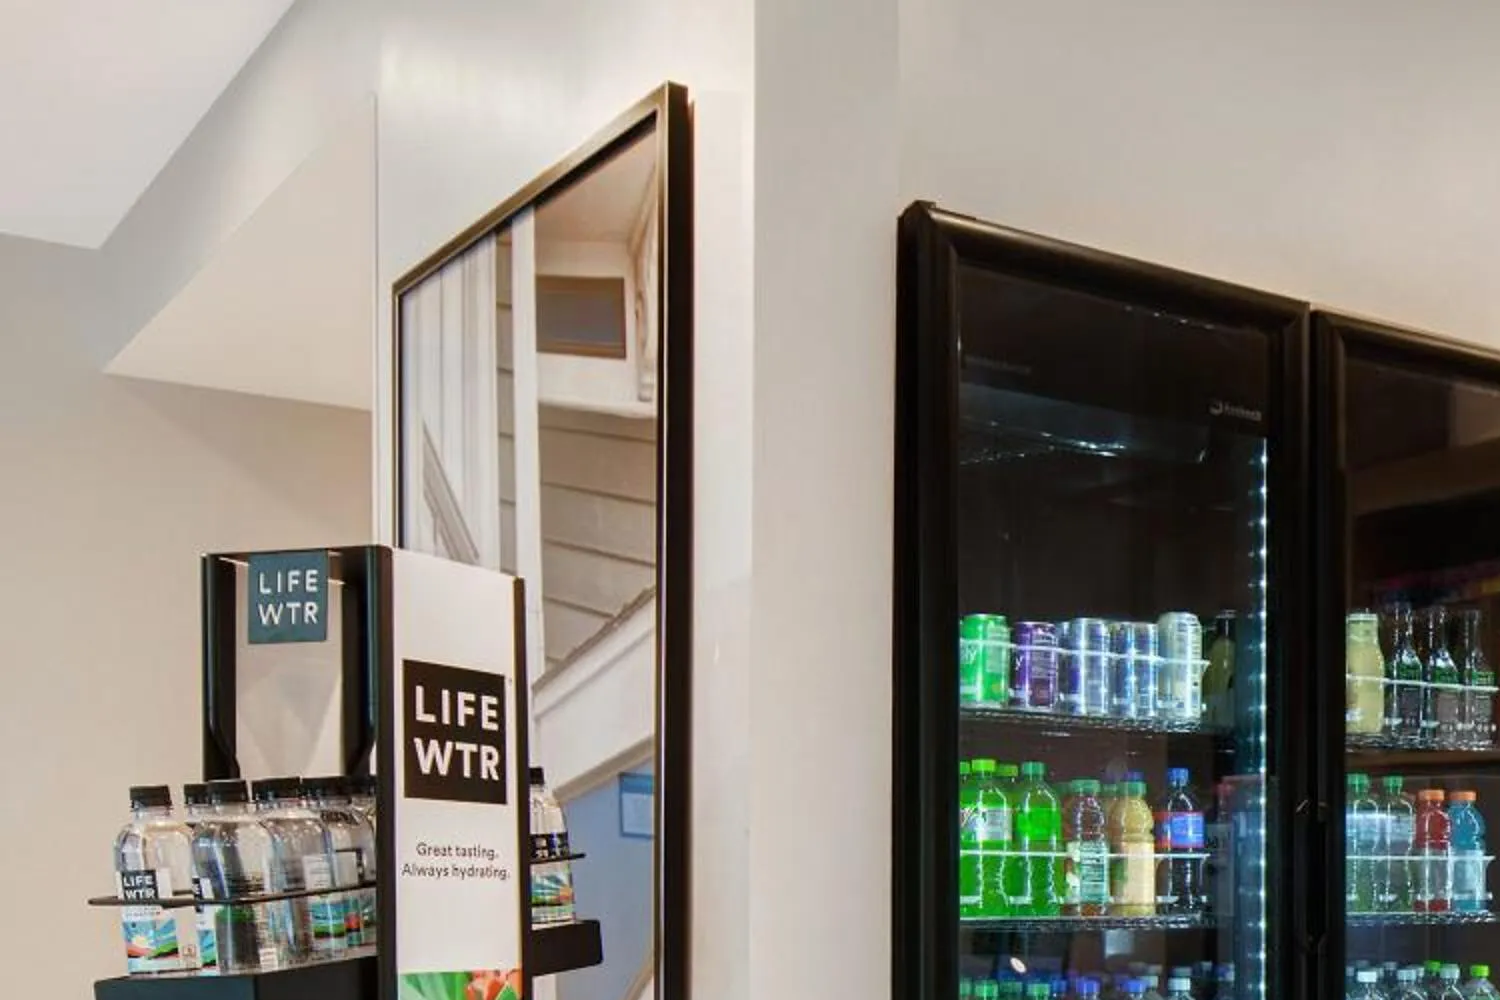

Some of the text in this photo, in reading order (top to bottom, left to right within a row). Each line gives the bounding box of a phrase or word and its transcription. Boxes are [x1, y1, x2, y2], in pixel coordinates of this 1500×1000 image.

[259, 569, 319, 595] LIFE
[258, 601, 319, 625] WTR
[415, 685, 499, 731] LIFE
[413, 737, 500, 781] WTR
[416, 841, 500, 861] Great tasting.
[123, 875, 153, 887] LIFE
[401, 863, 449, 880] Always
